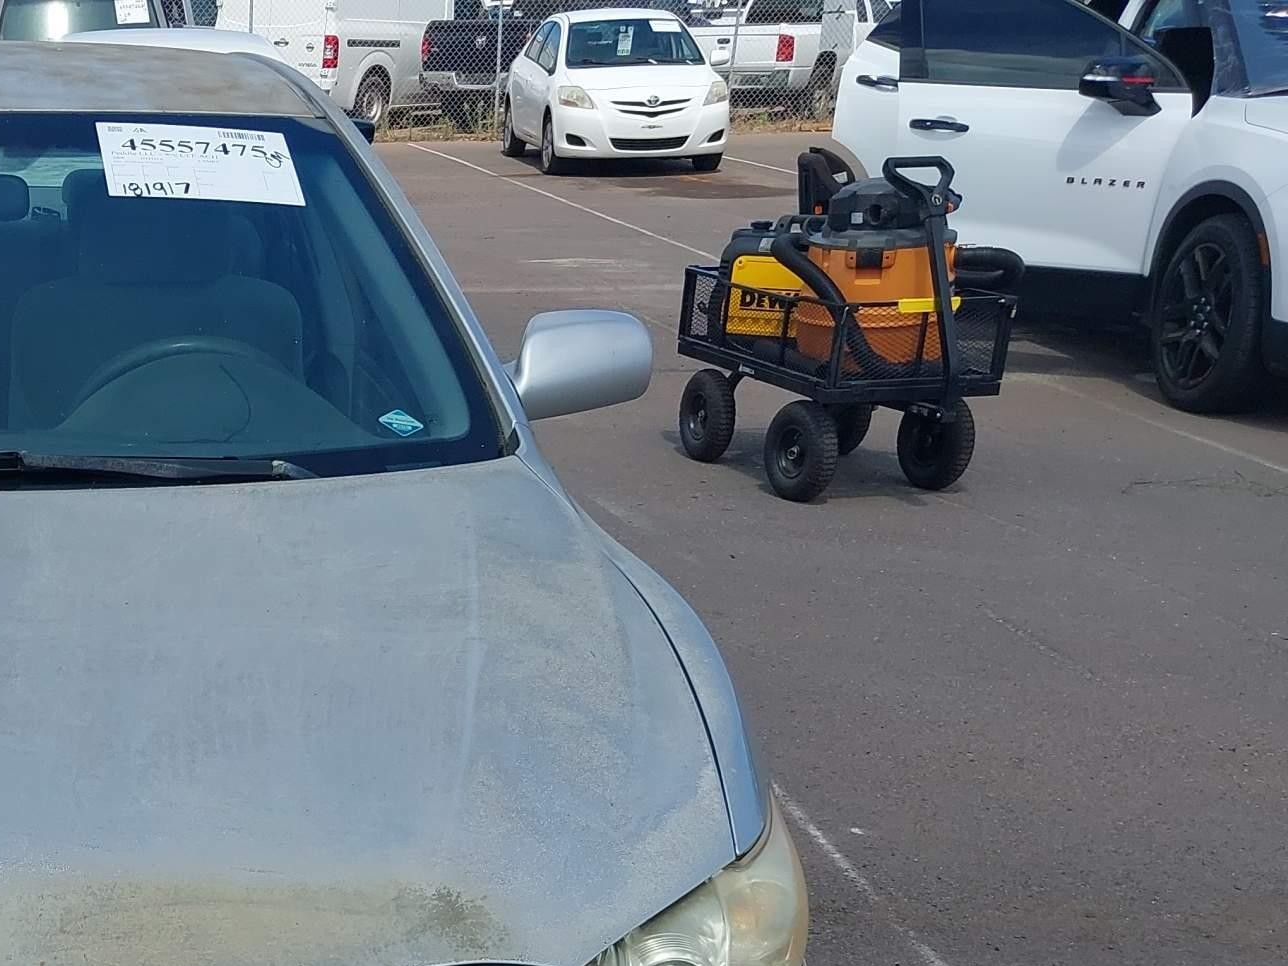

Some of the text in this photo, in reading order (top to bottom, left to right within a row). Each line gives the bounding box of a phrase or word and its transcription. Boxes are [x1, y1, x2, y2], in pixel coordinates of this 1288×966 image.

[121, 138, 267, 158] 45557475
[123, 182, 191, 197] 181917
[1065, 176, 1146, 189] BLAZER
